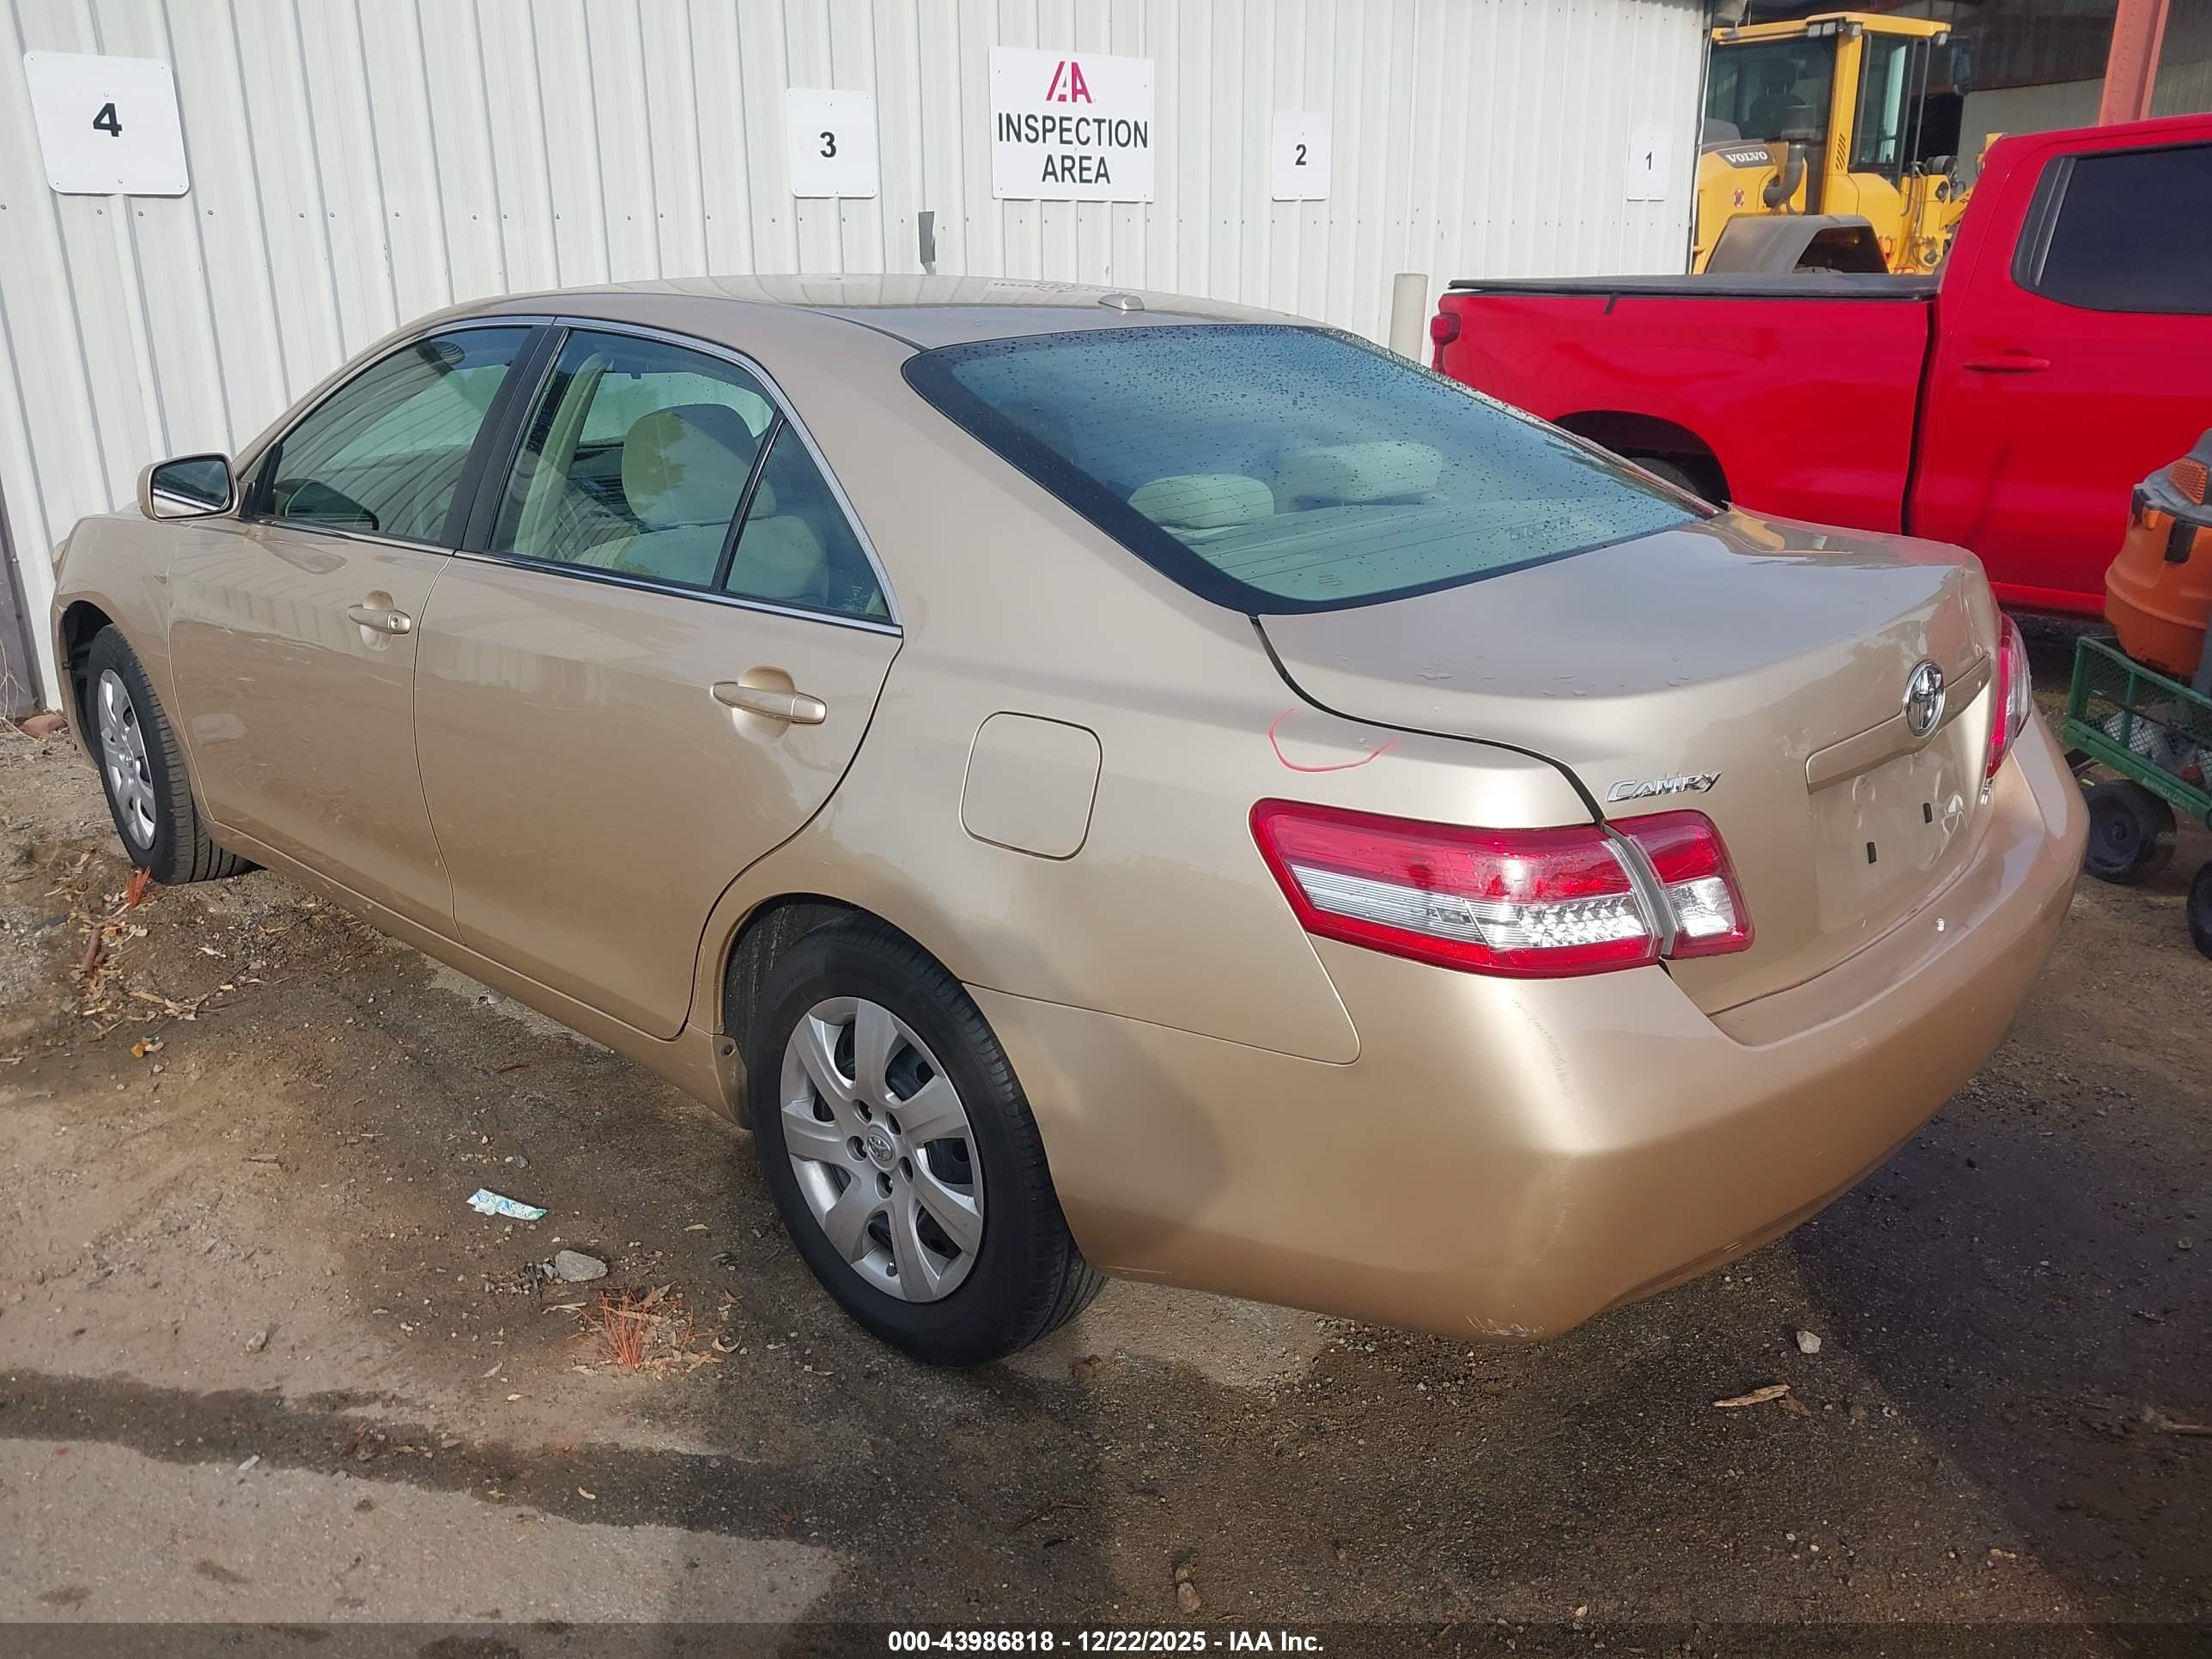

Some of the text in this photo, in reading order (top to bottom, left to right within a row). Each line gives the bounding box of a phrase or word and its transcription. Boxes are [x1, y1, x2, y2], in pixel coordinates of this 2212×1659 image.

[92, 102, 123, 137] 4
[998, 112, 1148, 149] INSPECTION
[819, 131, 837, 158] 3
[1295, 143, 1307, 167] 2
[1725, 150, 1769, 164] VOLVO
[1042, 154, 1111, 185] AREA
[1644, 151, 1653, 170] 1
[1606, 769, 1723, 802] CAMRY
